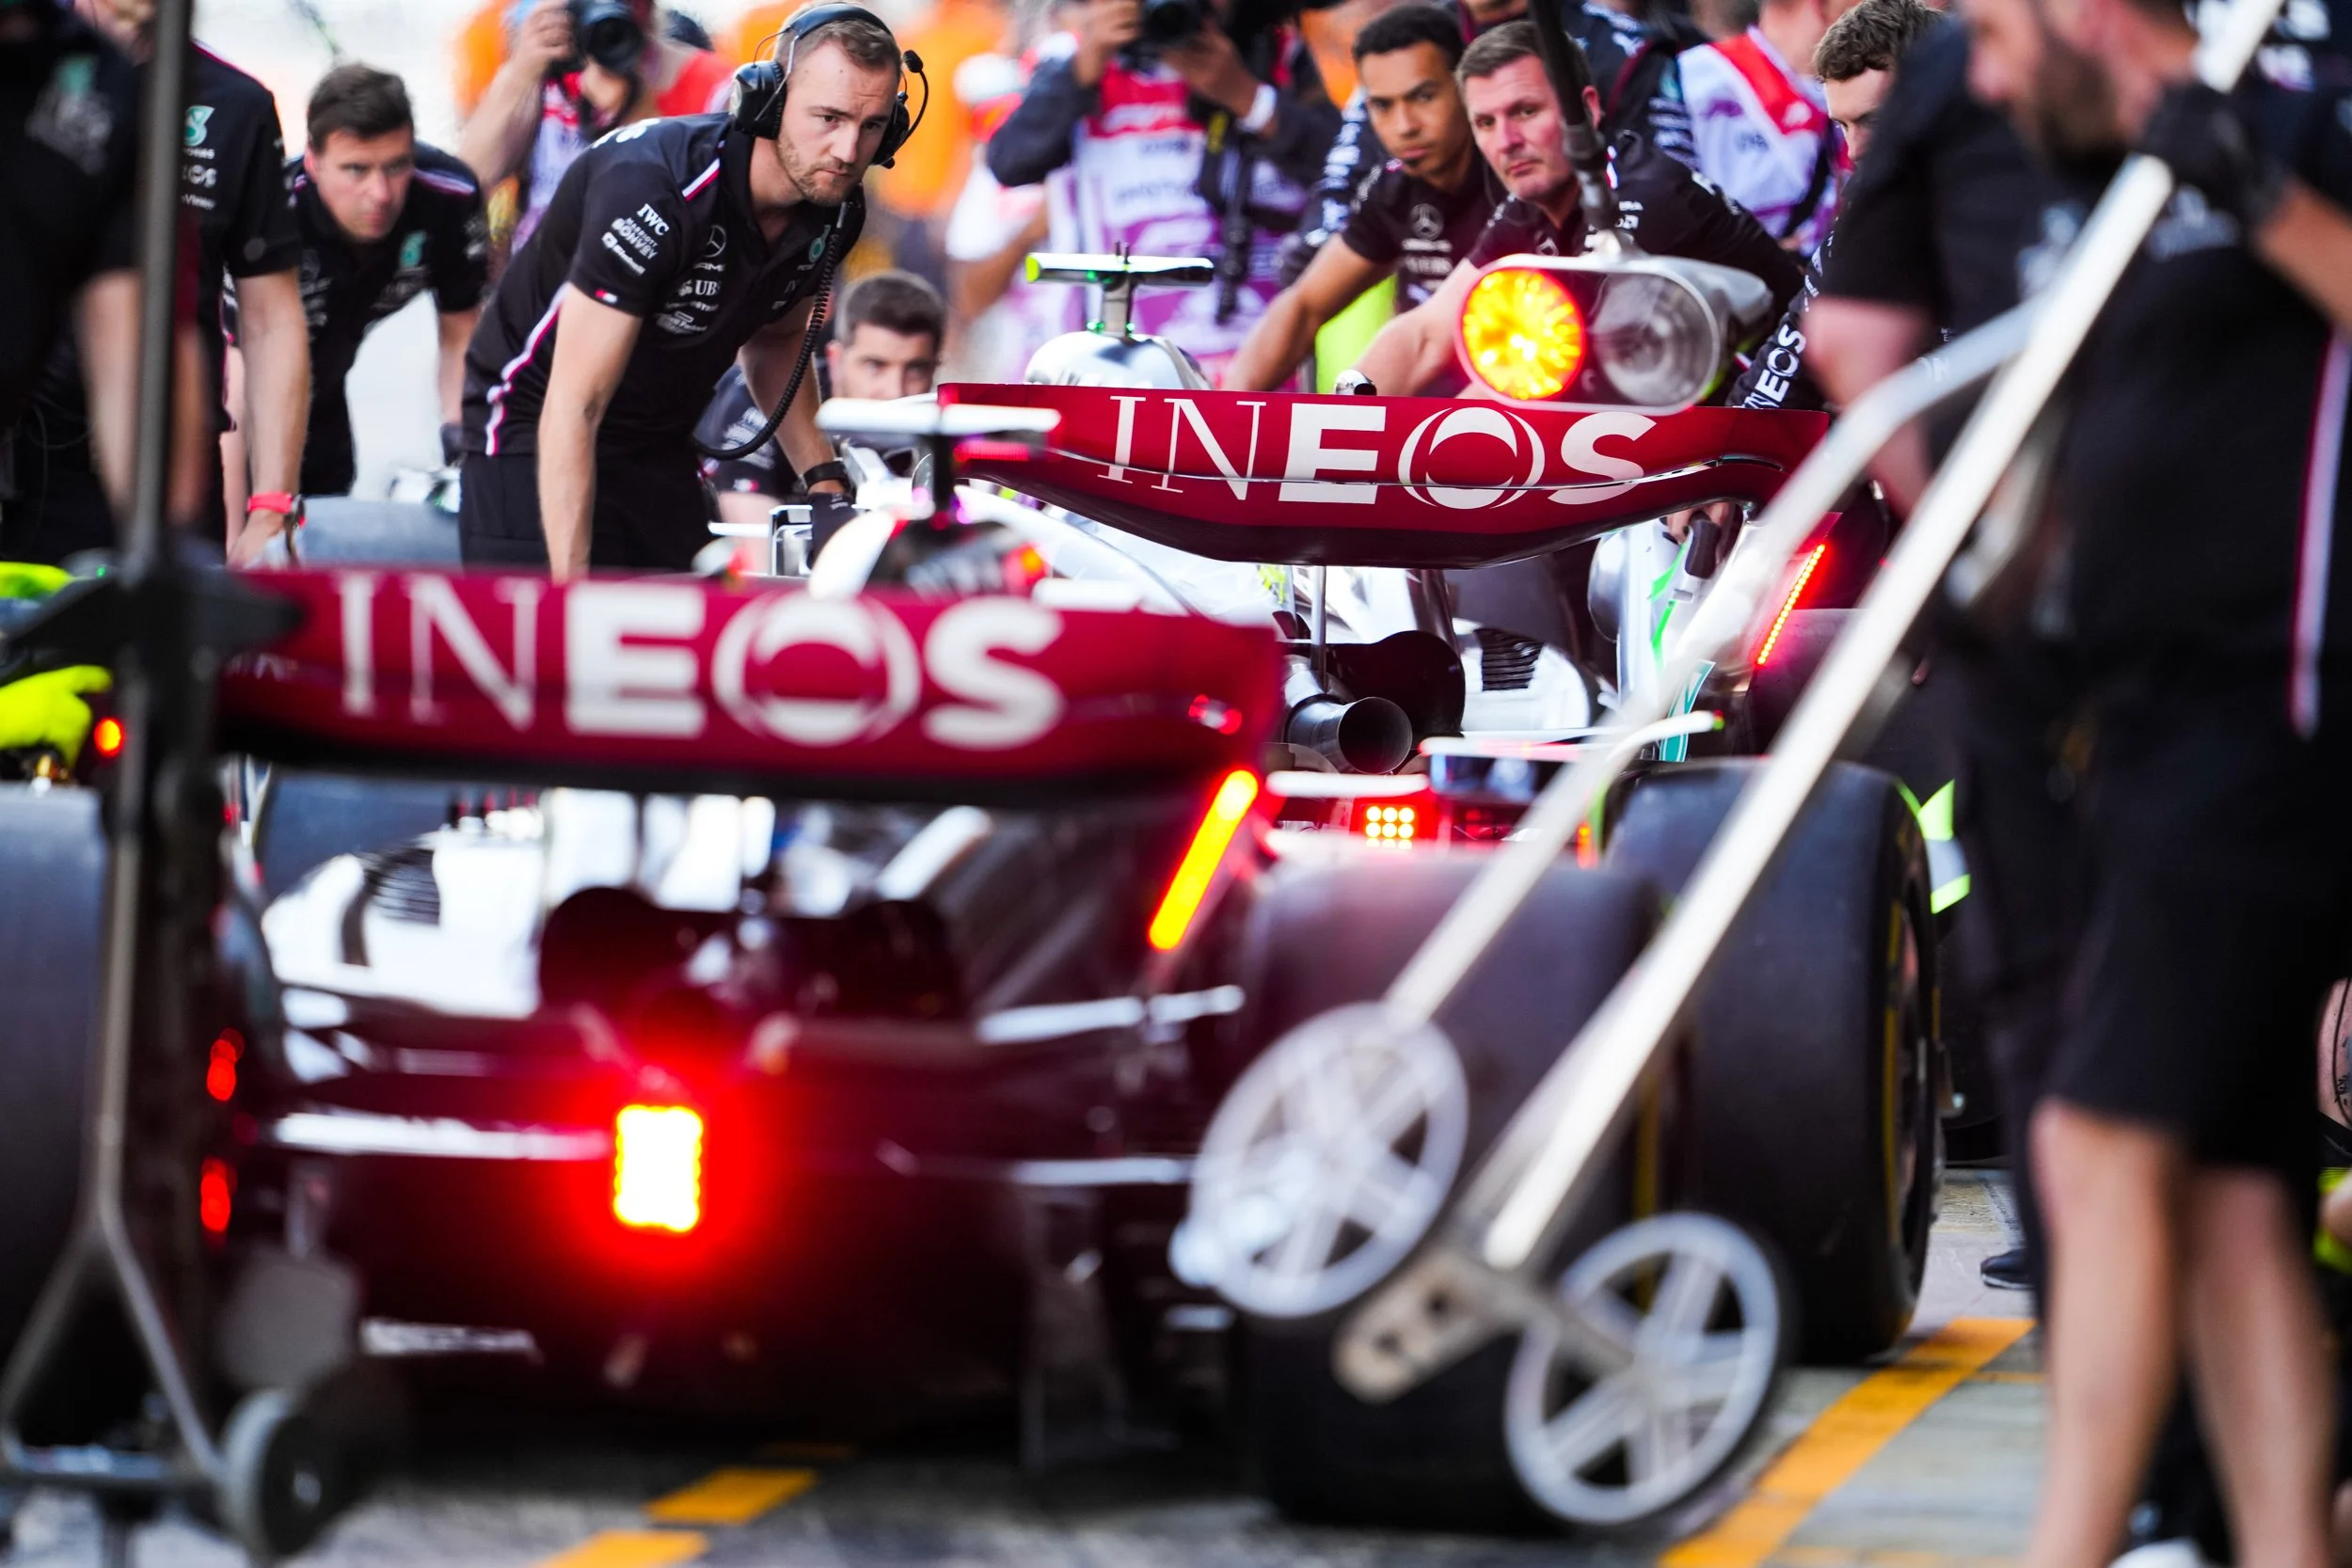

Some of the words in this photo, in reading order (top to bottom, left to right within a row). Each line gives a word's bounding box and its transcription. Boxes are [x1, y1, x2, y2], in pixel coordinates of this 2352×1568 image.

[637, 203, 670, 236] IWC
[694, 279, 721, 295] UB
[1740, 324, 1806, 409] NEOS
[1096, 395, 1659, 511] INEOS
[337, 572, 1066, 750] INEOS
